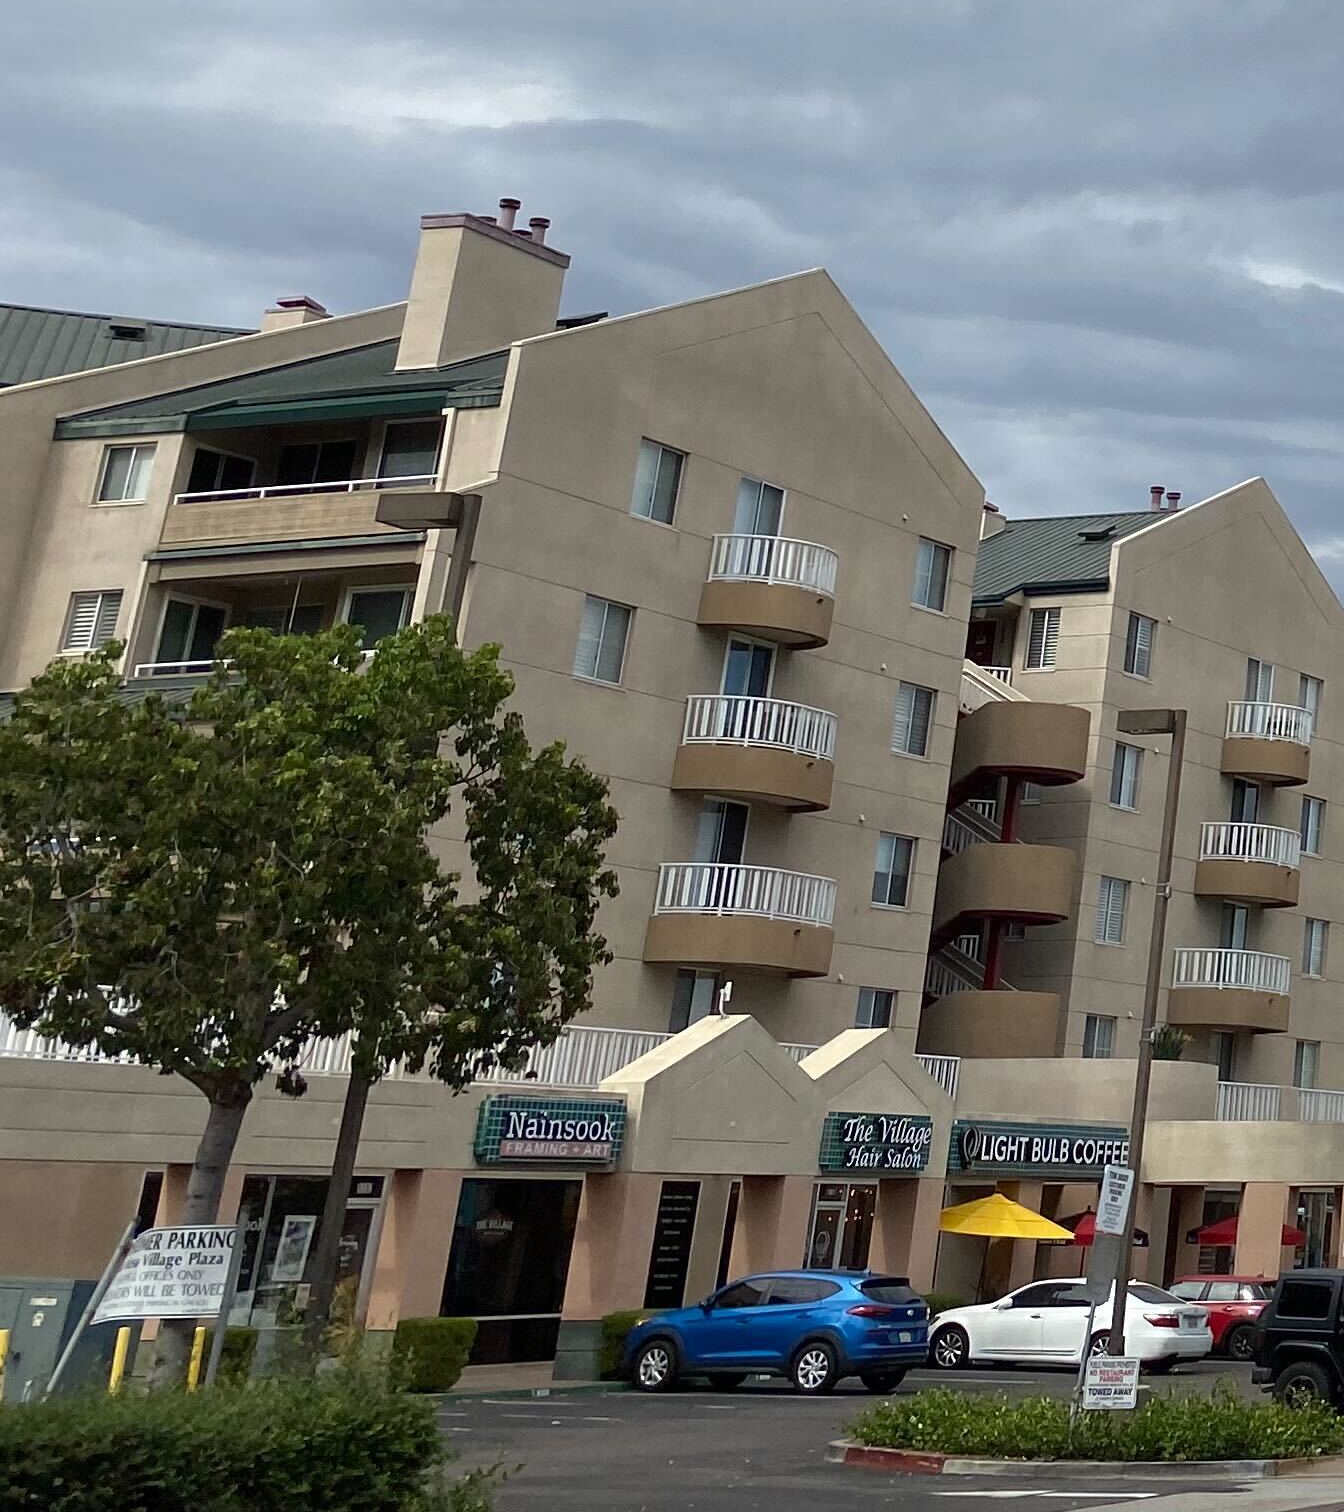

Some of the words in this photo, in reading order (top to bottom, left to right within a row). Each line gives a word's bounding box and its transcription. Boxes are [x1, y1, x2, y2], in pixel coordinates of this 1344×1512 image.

[843, 1115, 875, 1142] The
[878, 1116, 932, 1153] Village
[505, 1141, 567, 1155] FRAMING
[583, 1144, 611, 1157] ART
[846, 1144, 883, 1168] Hair
[884, 1146, 922, 1169] Salon
[981, 1135, 1029, 1161] LIGHT
[1031, 1138, 1069, 1163] BULB
[1072, 1139, 1129, 1165] COFFEE
[143, 1252, 182, 1269] Village
[188, 1252, 224, 1266] Plaza
[133, 1284, 156, 1298] WILL
[161, 1284, 177, 1297] BE
[1088, 1387, 1112, 1396] TOWED
[1113, 1387, 1133, 1396] AWAY
